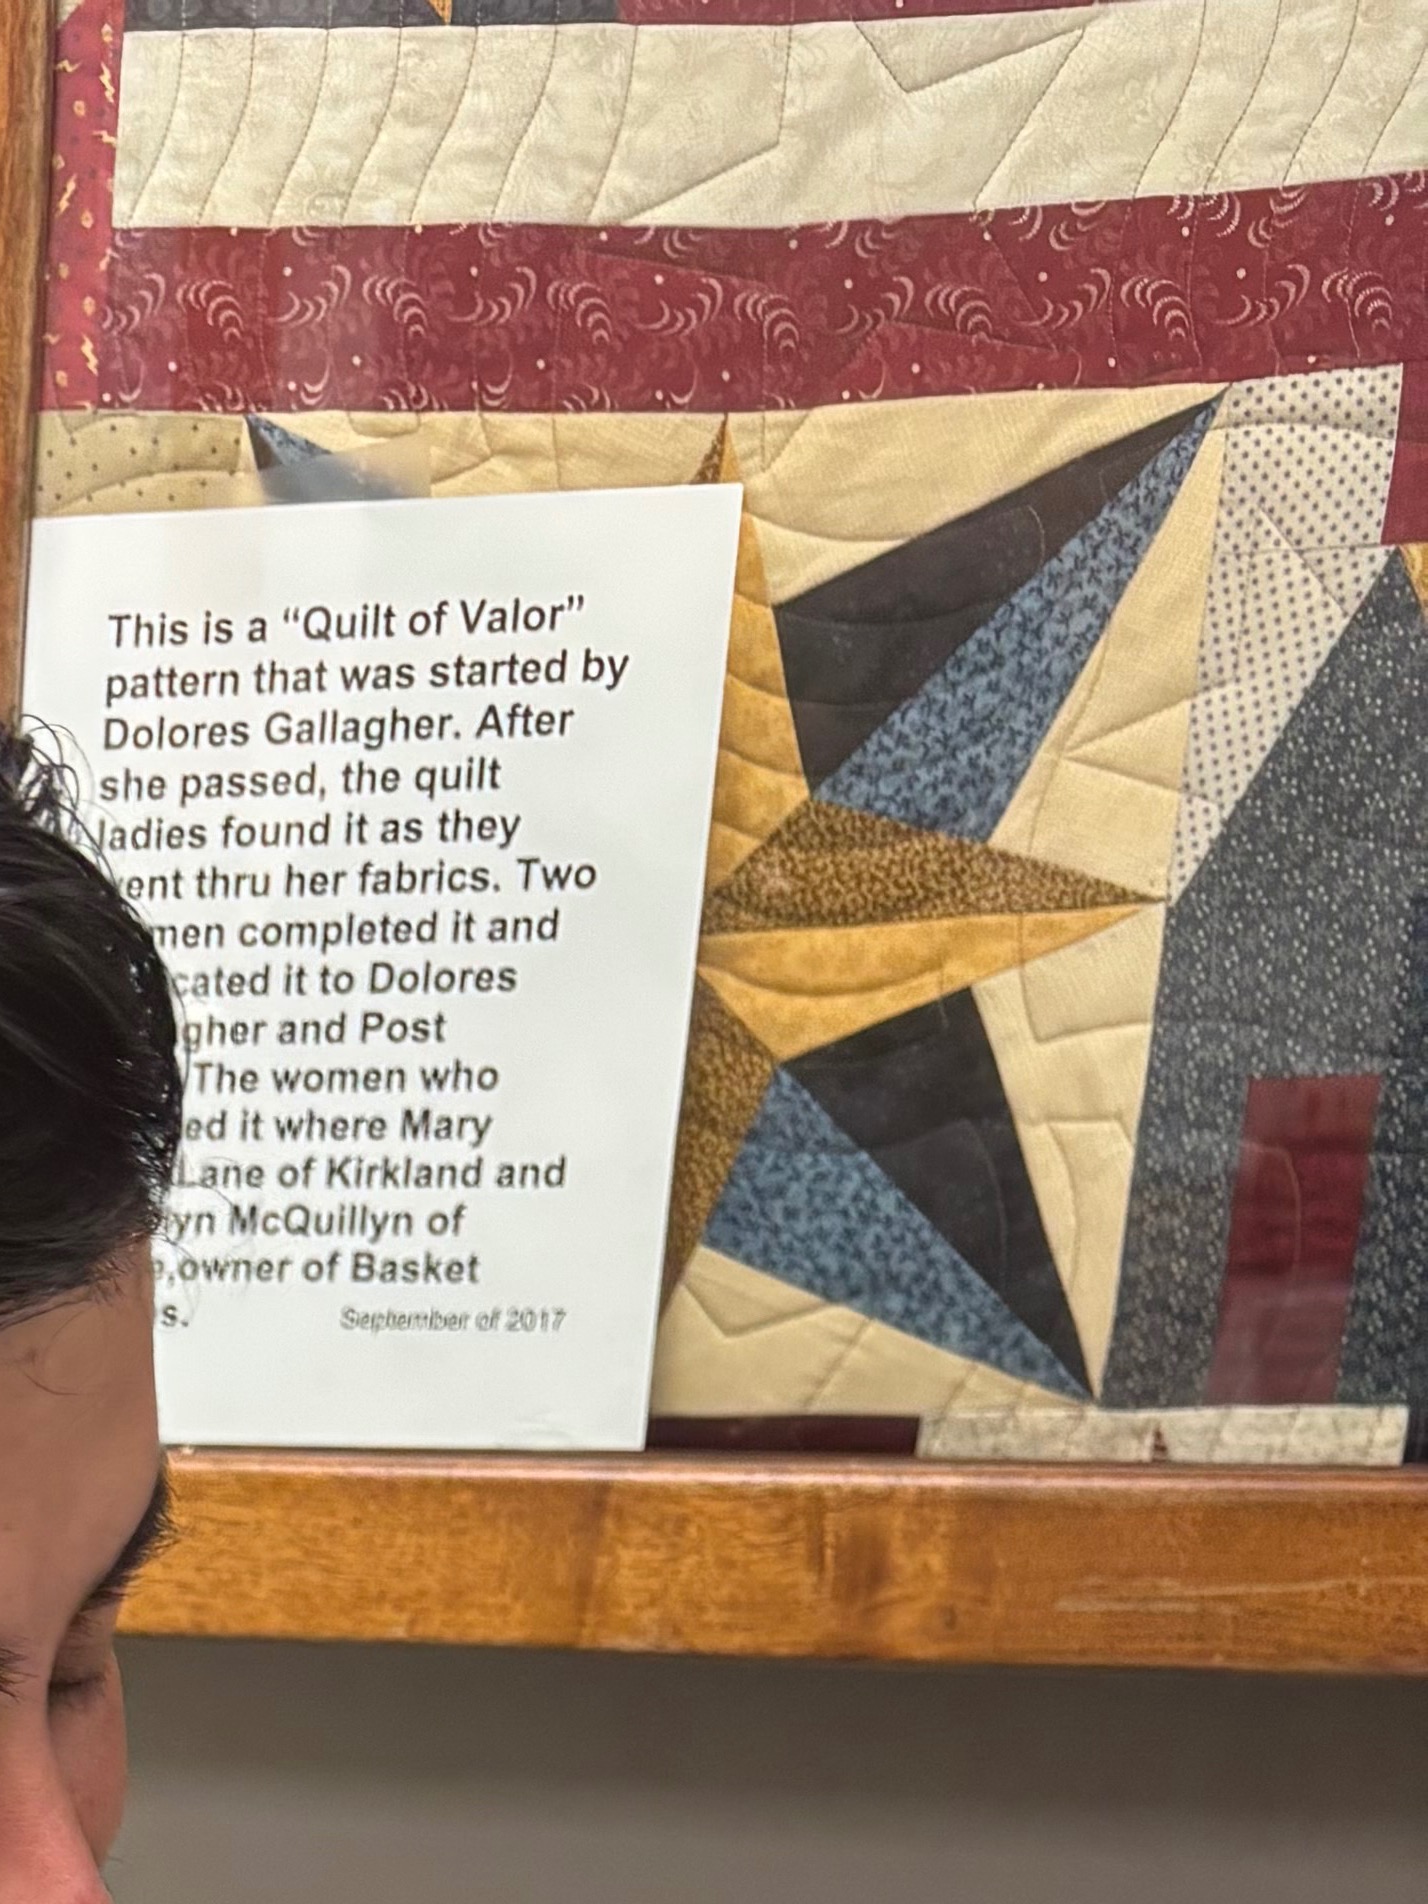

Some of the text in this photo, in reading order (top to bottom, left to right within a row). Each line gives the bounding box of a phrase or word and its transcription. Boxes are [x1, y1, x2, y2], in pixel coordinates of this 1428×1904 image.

[109, 595, 583, 647] This is a “Quilt of Valor”
[107, 648, 629, 707] pattern that was started by
[105, 703, 574, 750] Dolores Gallagher. After
[101, 757, 500, 807] she passed, the quilt
[96, 809, 520, 854] ladies found it as they
[118, 858, 596, 901] ent thru her fabrics. Two
[151, 908, 559, 954] men completed it and
[174, 962, 516, 999] cated it to Dolores
[182, 1011, 444, 1053] gher and Post
[195, 1059, 498, 1092] The women who
[185, 1108, 492, 1147] ed it where Mary
[278, 1157, 315, 1187] of
[327, 1157, 483, 1187] Kirkland
[497, 1156, 565, 1187] and
[166, 1203, 466, 1243] yn McQuillyn of
[303, 1251, 340, 1282] of
[352, 1252, 477, 1282] Basket
[160, 1303, 190, 1329] s.
[339, 1306, 568, 1333] September of 2017
